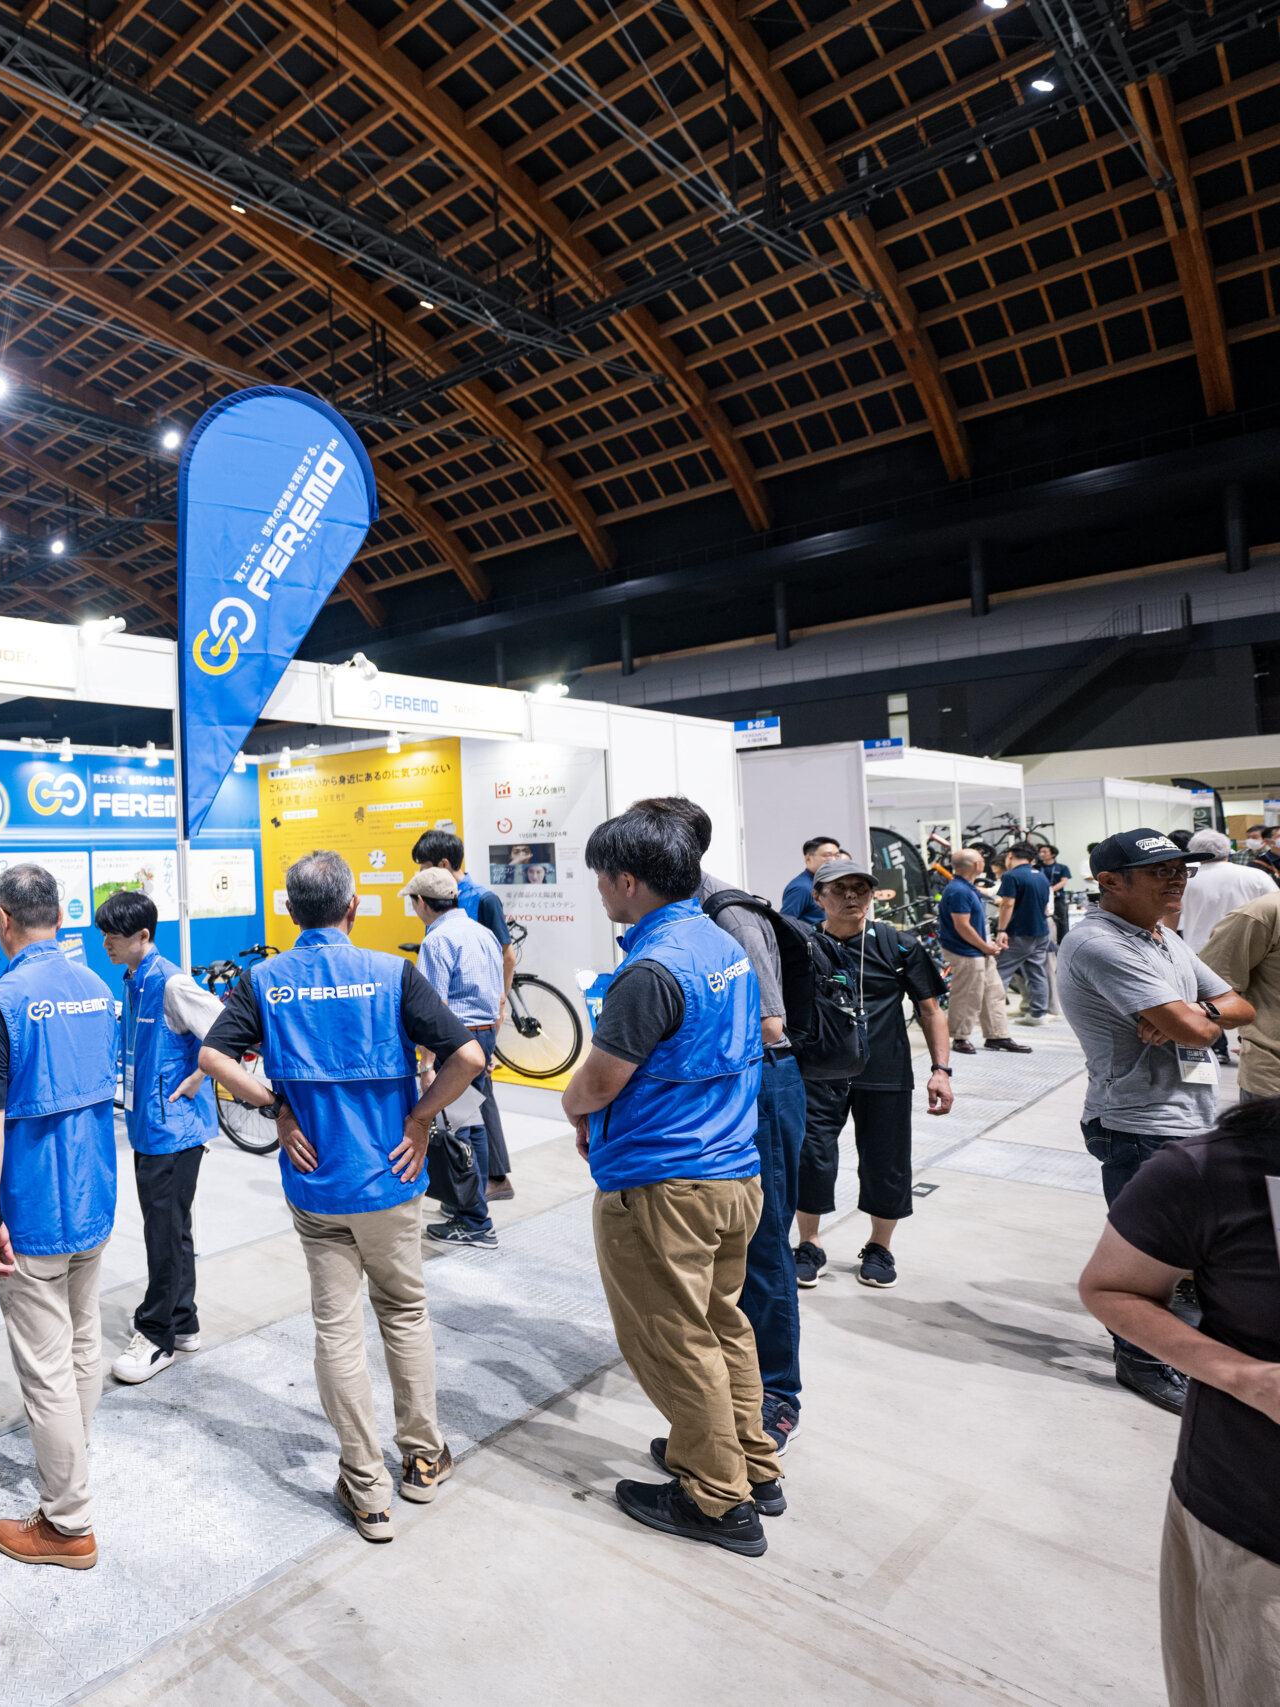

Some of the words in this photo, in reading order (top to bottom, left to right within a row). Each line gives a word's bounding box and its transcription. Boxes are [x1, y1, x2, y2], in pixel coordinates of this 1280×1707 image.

[384, 694, 439, 714] FEREMO
[93, 792, 177, 818] FEREM
[536, 914, 574, 922] YUDEN
